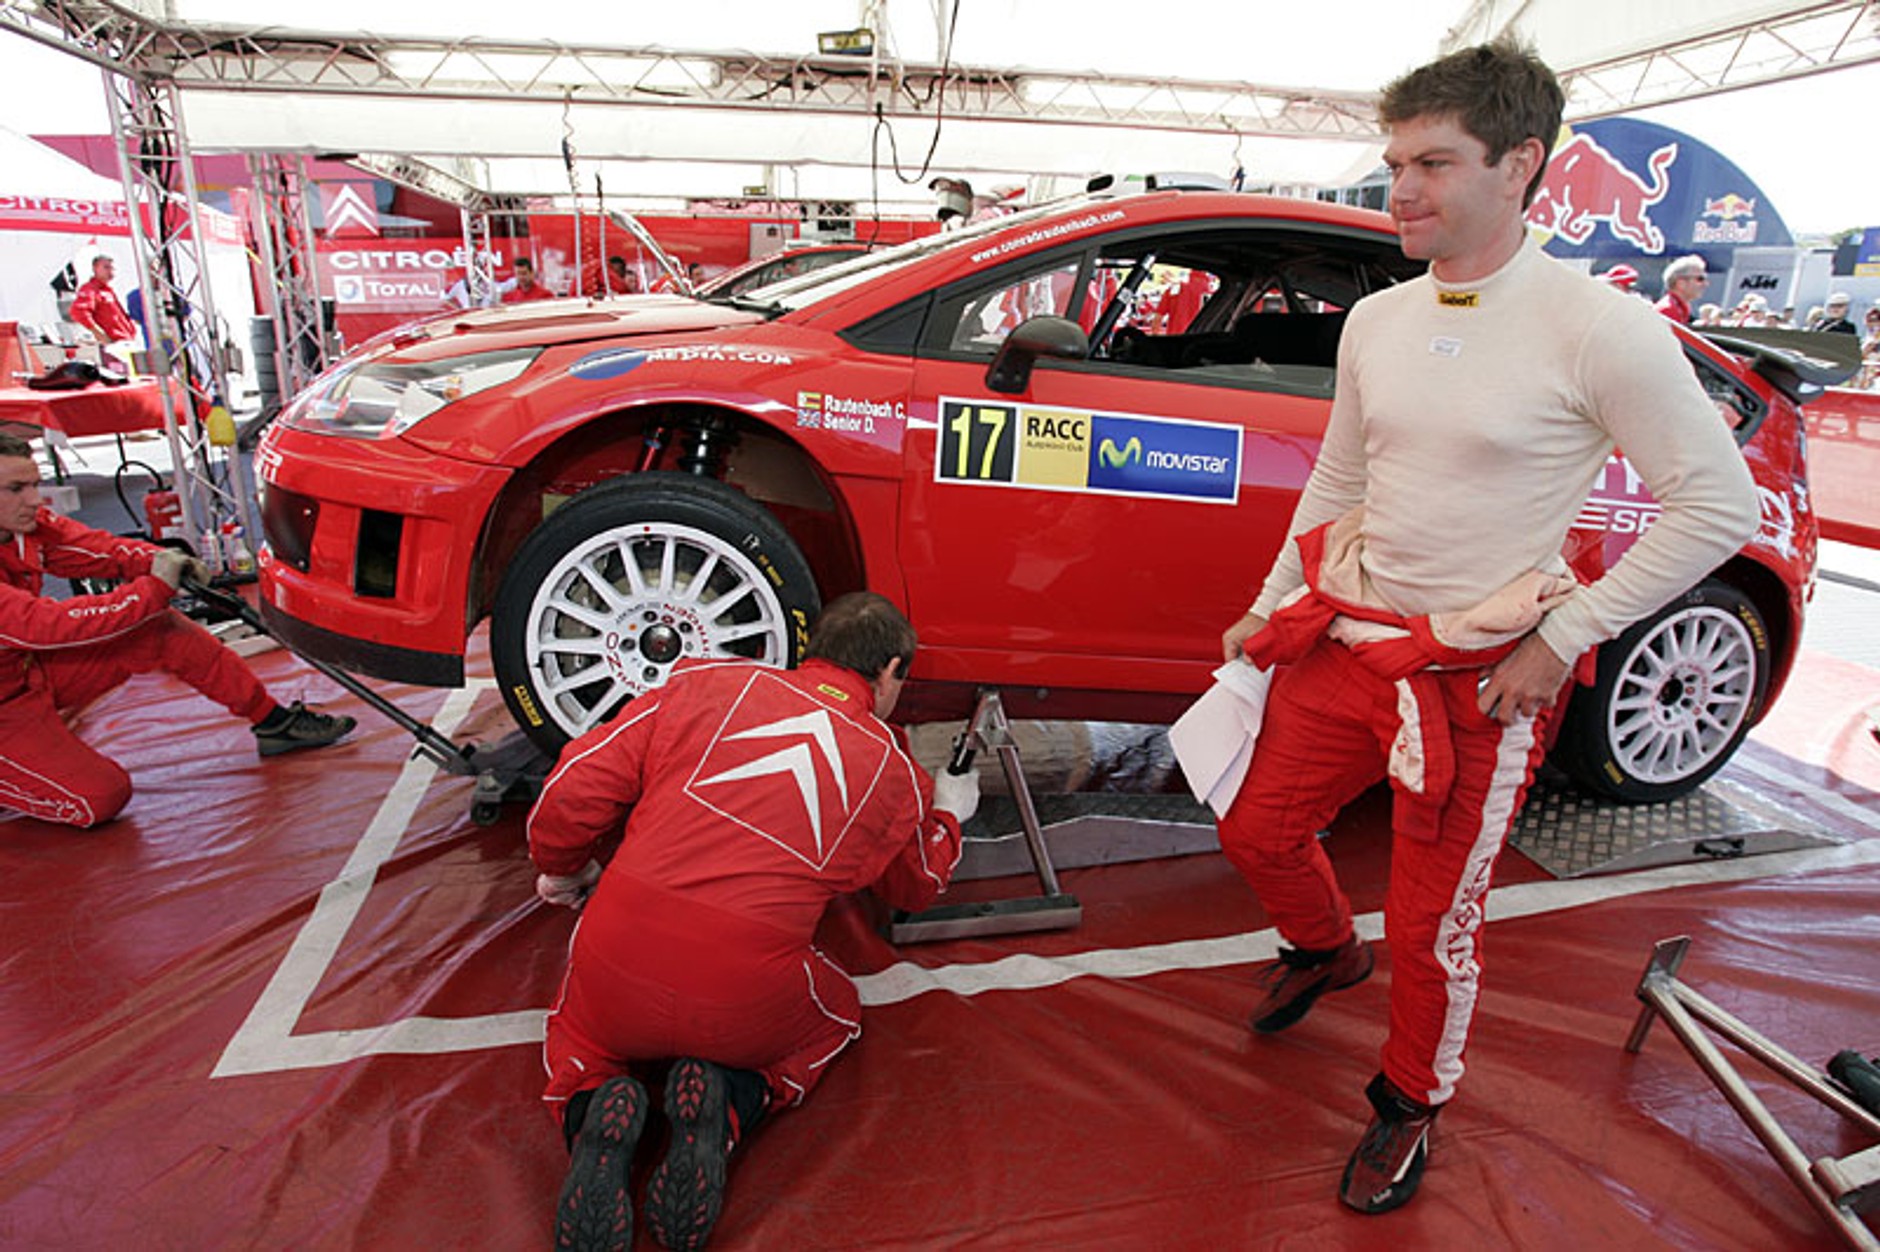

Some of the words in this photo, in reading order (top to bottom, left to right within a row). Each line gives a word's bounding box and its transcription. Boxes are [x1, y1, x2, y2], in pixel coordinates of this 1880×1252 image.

[825, 394, 892, 418] Rautenbach
[895, 402, 906, 420] C.
[824, 411, 861, 431] Senior
[864, 416, 876, 434] D.
[1026, 416, 1084, 440] RACC
[951, 406, 1006, 479] 17
[1146, 450, 1230, 474] movistar
